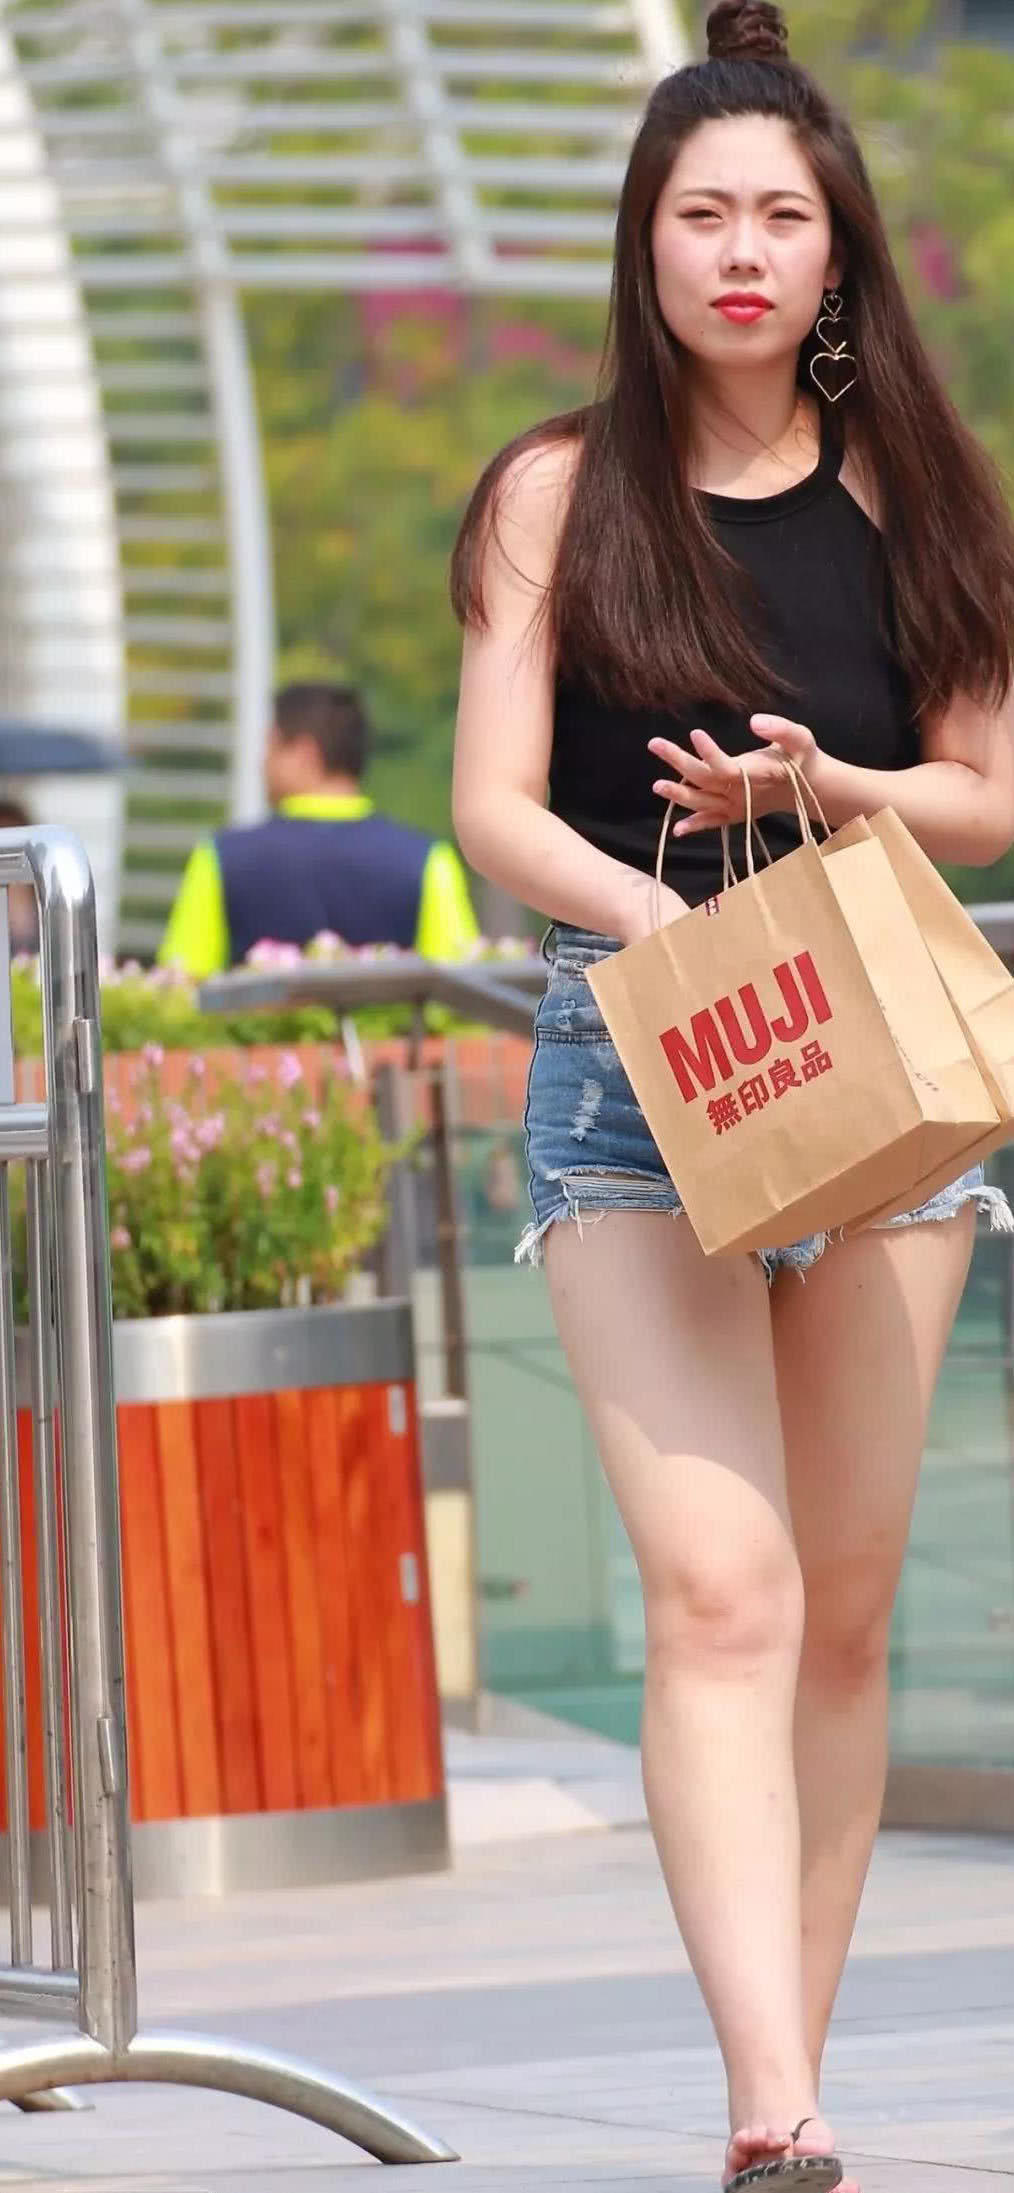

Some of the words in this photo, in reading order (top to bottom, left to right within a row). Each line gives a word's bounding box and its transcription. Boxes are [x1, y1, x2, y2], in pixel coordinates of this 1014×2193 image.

[659, 950, 833, 1104] MUJI
[705, 1040, 833, 1135] 無印良品
